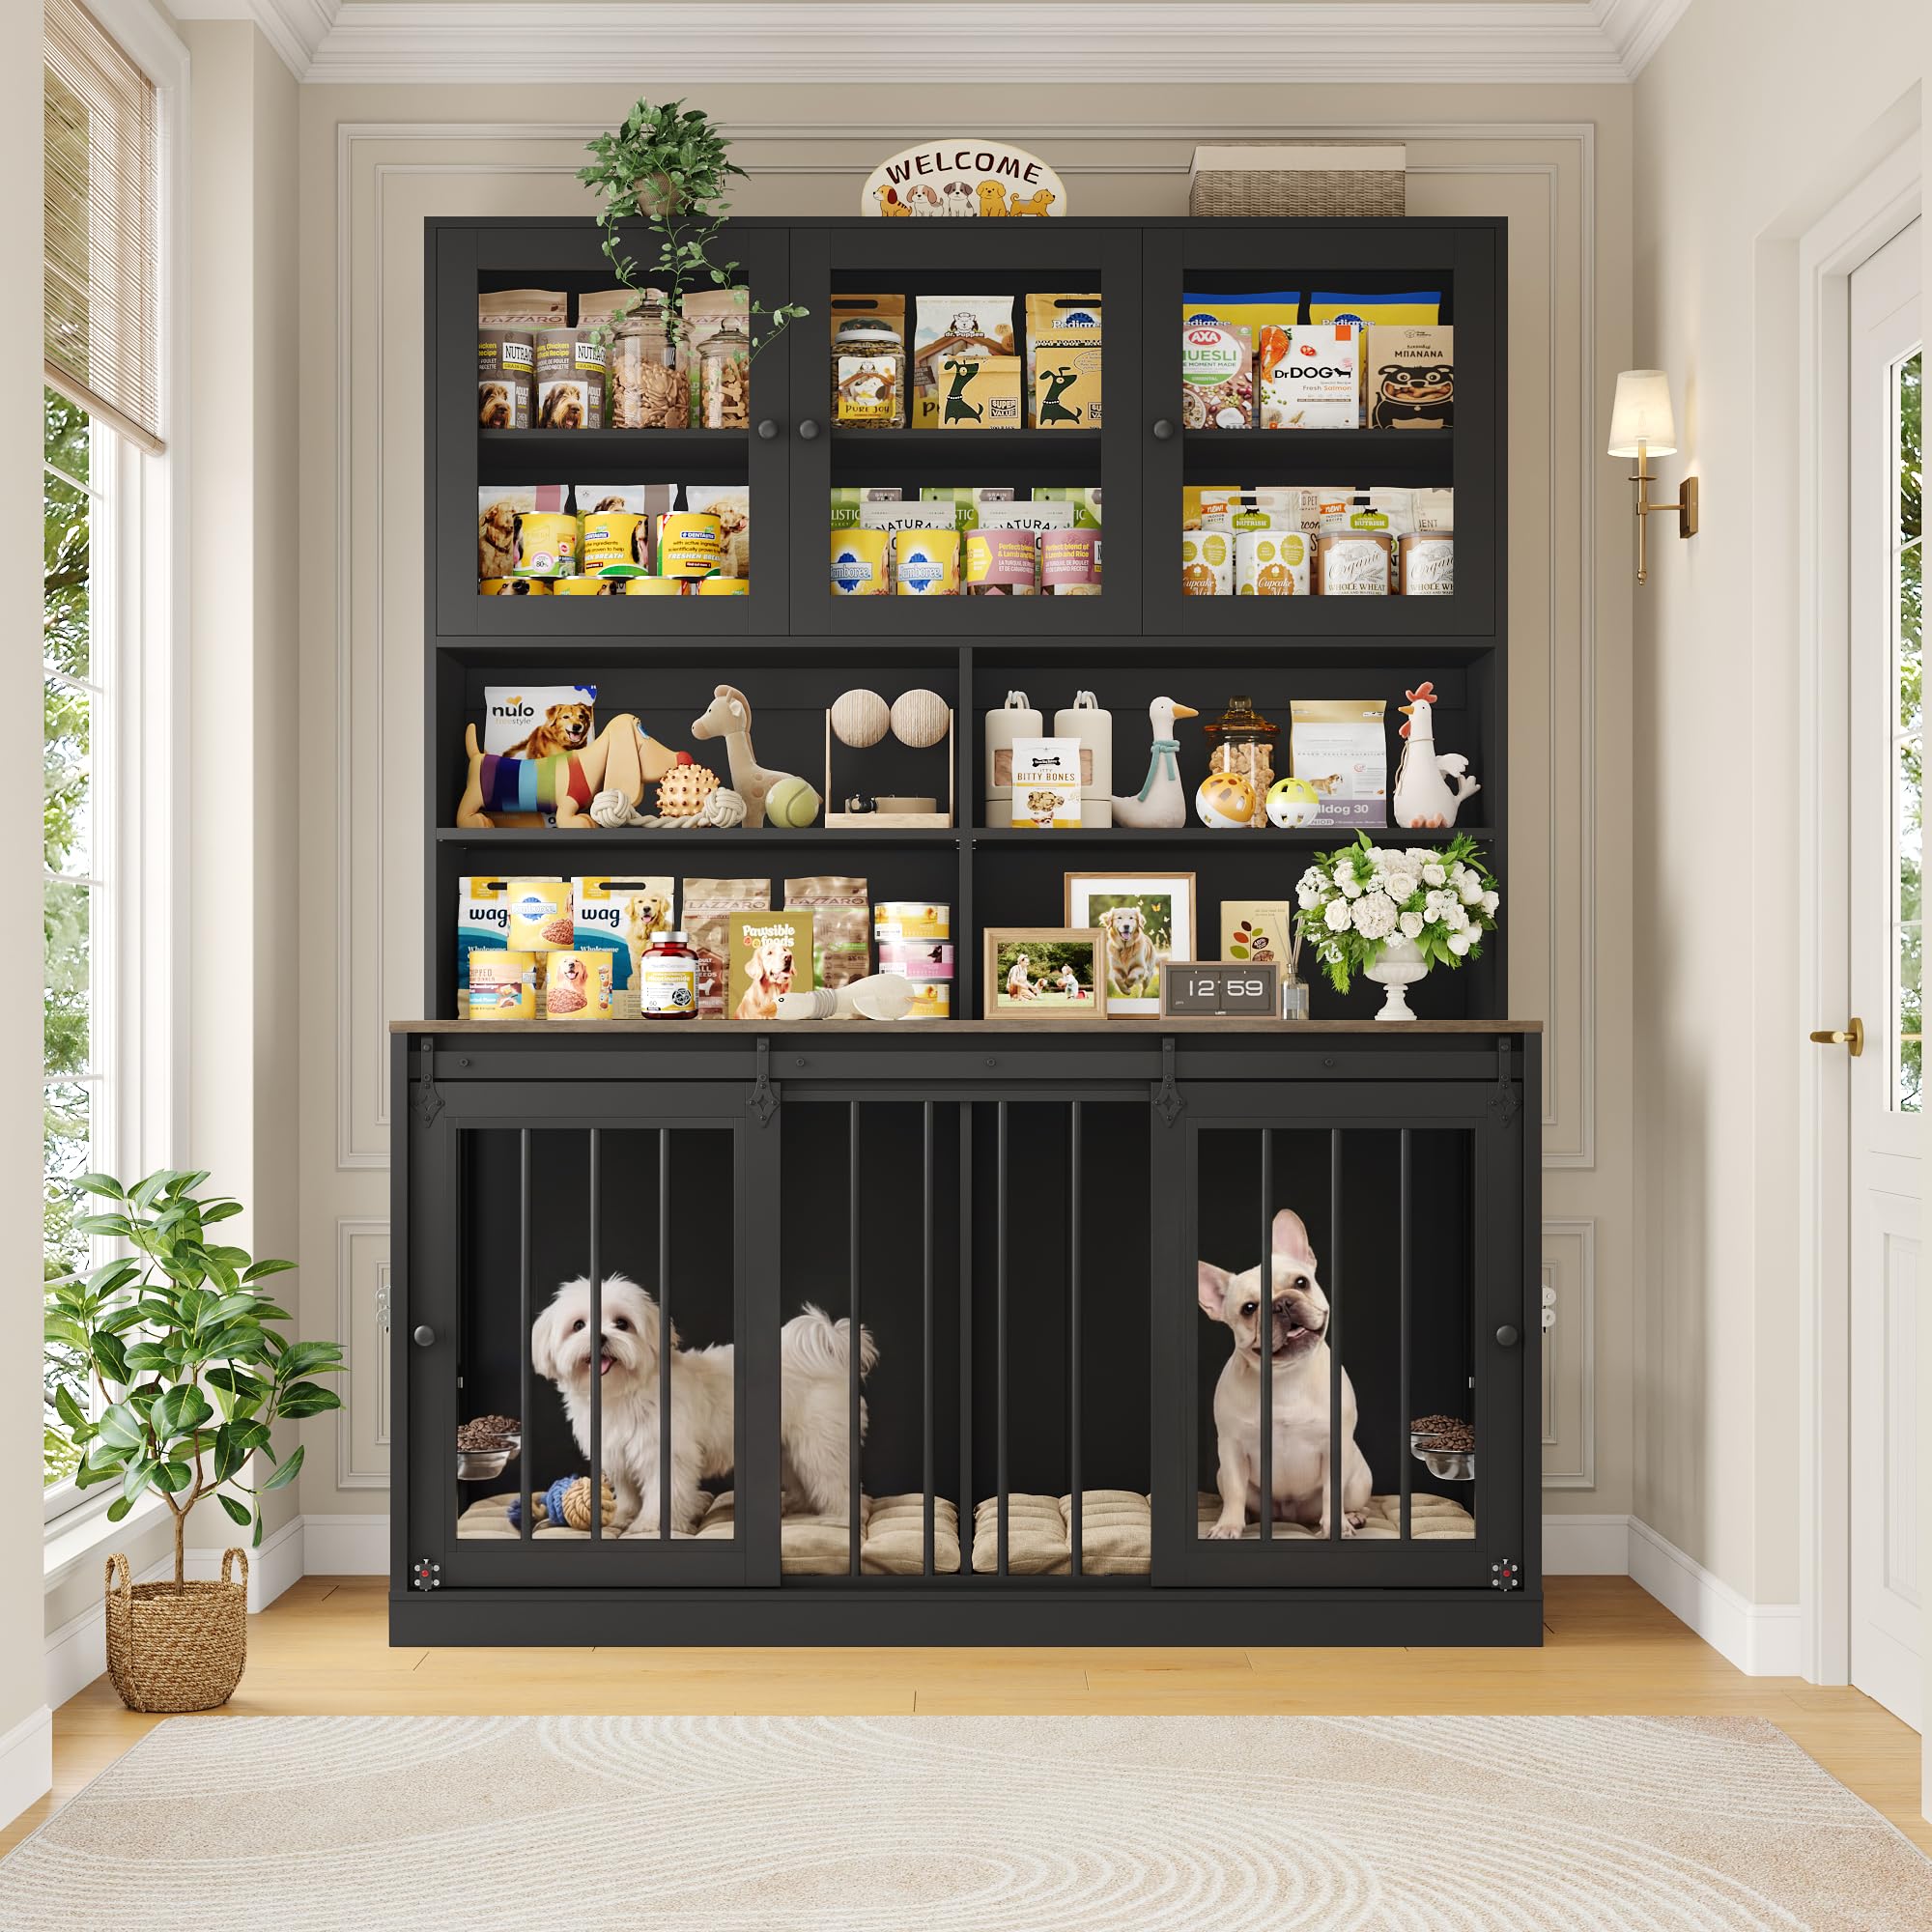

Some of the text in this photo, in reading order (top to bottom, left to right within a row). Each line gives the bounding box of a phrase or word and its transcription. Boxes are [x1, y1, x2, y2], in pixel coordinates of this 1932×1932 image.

[886, 152, 1043, 185] WELCOME
[482, 315, 562, 324] LAZZARO
[1052, 319, 1101, 328] Pedigre
[1191, 331, 1219, 343] AXA
[516, 386, 528, 396] ADULT
[588, 386, 601, 396] ADULT
[845, 405, 869, 413] PURE
[992, 400, 1016, 409] SUPER
[1307, 496, 1318, 505] PET
[831, 509, 860, 521] LISTIC
[1258, 577, 1292, 587] Cupcake
[1328, 582, 1385, 591] WHOLE WHEAT
[492, 702, 534, 717] nulo
[1317, 805, 1369, 814] lldog 30
[469, 909, 507, 927] wag
[582, 909, 620, 927] wag
[742, 923, 795, 936] Pawsible
[761, 935, 795, 947] foods
[1189, 980, 1264, 997] 12 59
